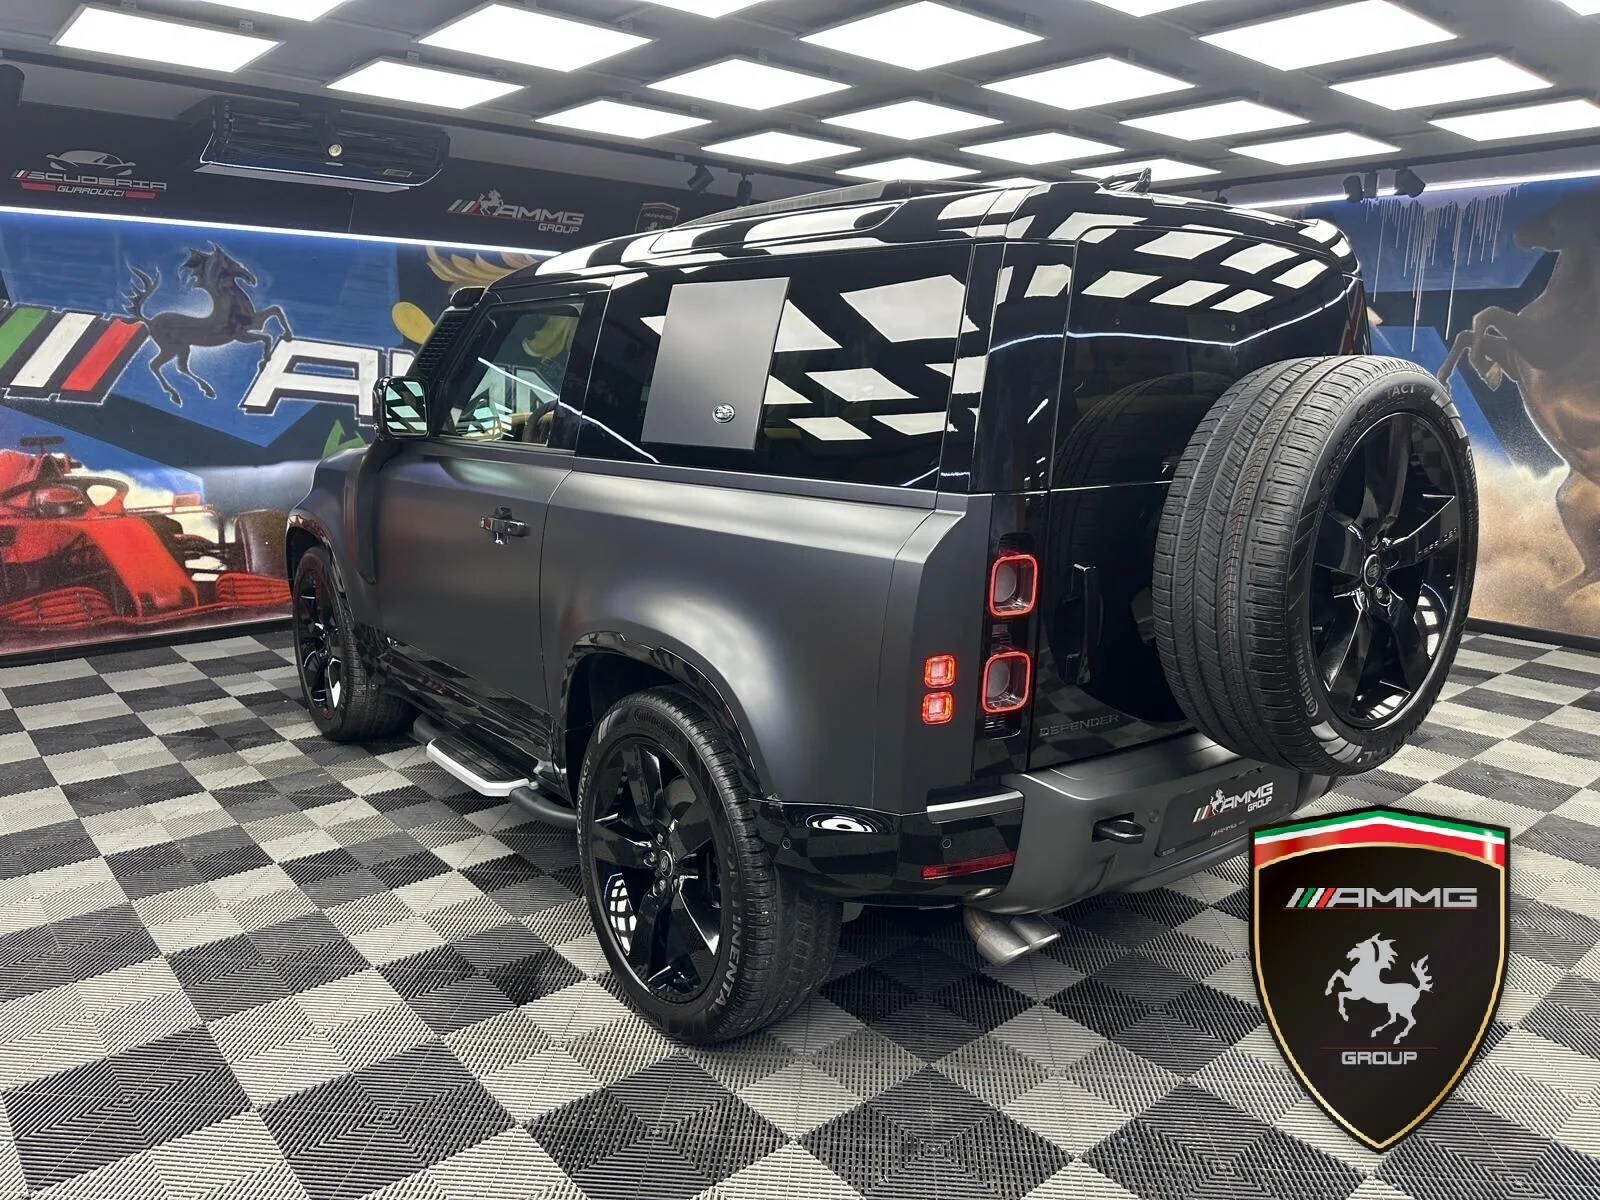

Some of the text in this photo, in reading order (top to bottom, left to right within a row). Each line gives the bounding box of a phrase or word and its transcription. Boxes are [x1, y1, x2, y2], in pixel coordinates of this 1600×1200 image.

[26, 170, 168, 193] SCUDERIA
[494, 204, 585, 226] AMMG
[537, 223, 580, 235] GROUP
[1039, 713, 1120, 737] DEFENDER
[1219, 781, 1274, 813] AMMG
[1247, 796, 1273, 812] GROUP
